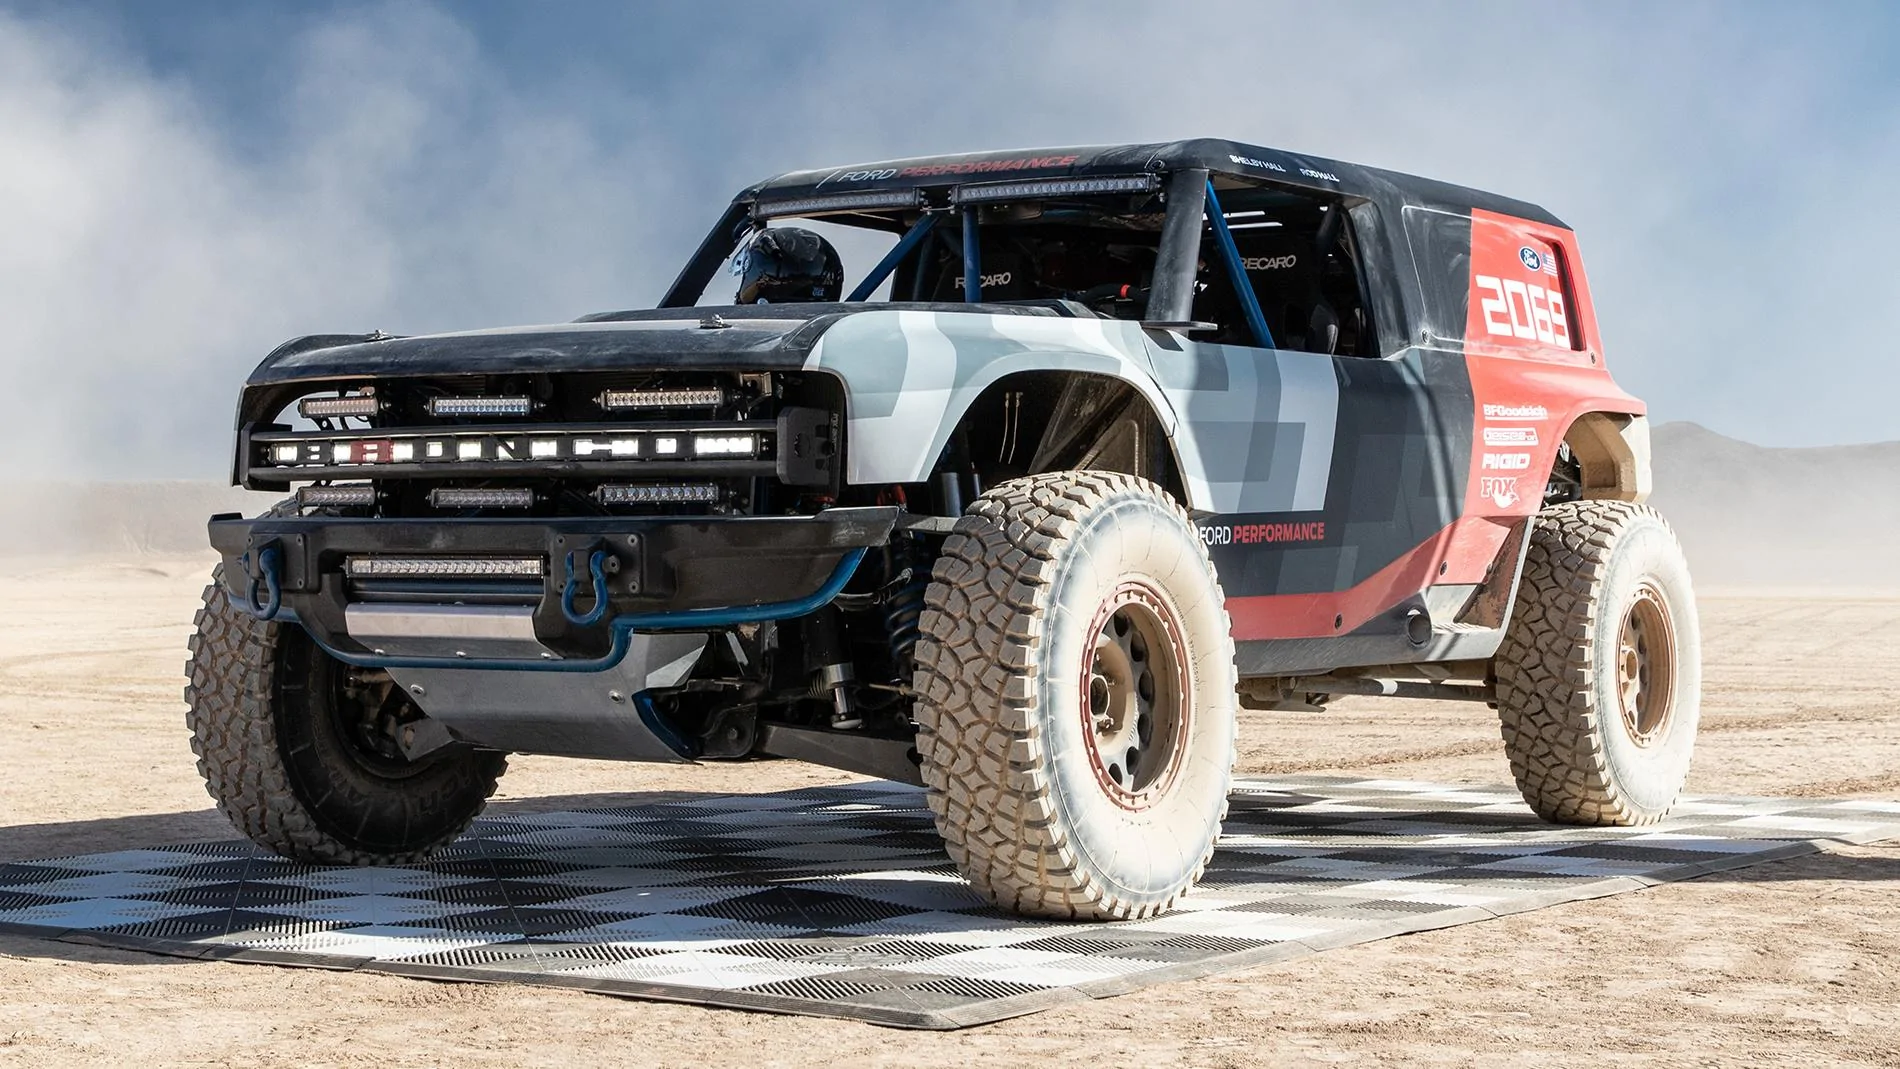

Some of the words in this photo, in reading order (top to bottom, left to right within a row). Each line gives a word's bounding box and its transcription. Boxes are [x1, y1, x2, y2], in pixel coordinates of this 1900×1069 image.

[837, 168, 897, 182] FORD
[899, 155, 1080, 177] PERFORMANCE
[1239, 254, 1297, 270] RECARO
[955, 271, 1011, 289] RCARO
[1475, 274, 1571, 350] 2069
[1481, 477, 1517, 498] FOX
[1200, 526, 1231, 546] FORD
[1233, 522, 1325, 544] PERFORMANCE
